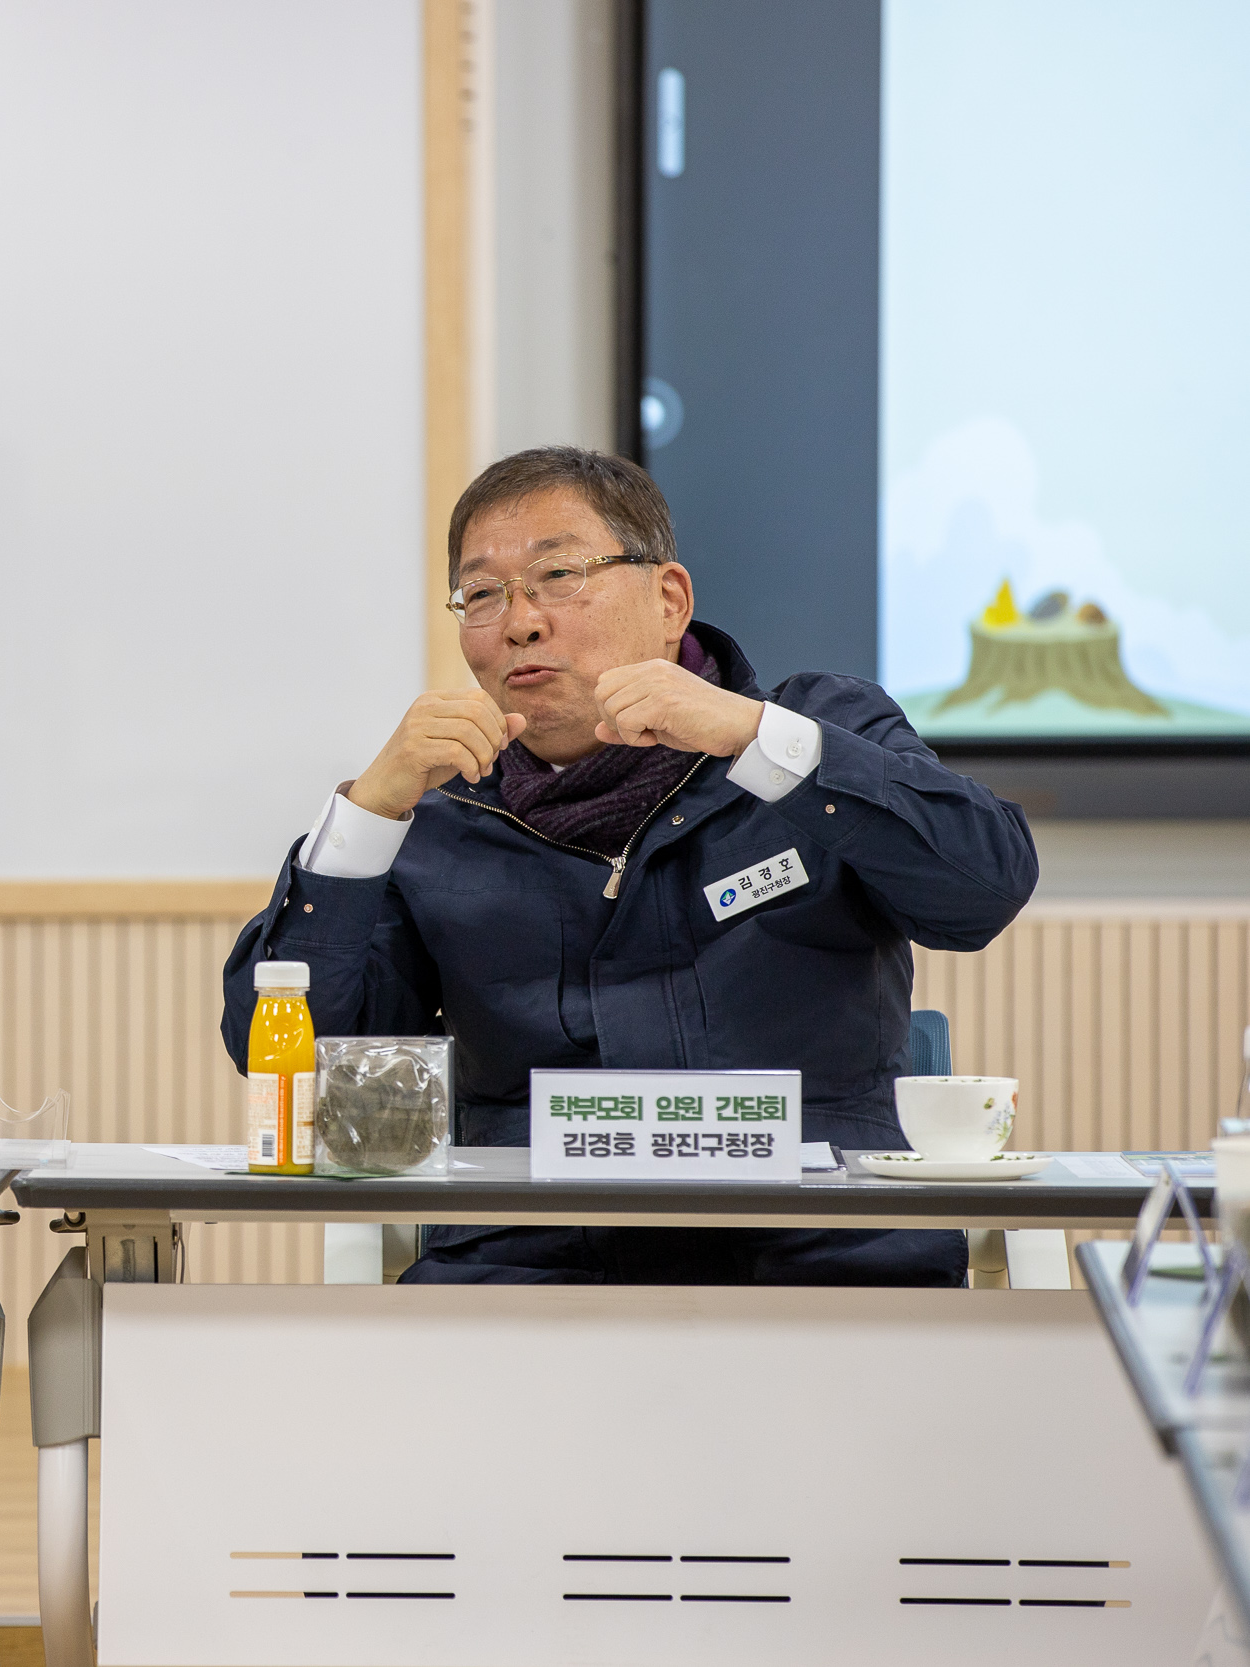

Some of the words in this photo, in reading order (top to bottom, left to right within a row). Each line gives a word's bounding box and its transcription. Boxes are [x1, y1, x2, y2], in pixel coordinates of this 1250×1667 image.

[751, 875, 791, 898] 광진구청장
[550, 1095, 644, 1121] 학부모회
[656, 1095, 704, 1121] 임원
[715, 1095, 787, 1122] 간담회
[563, 1132, 636, 1158] 김경호
[651, 1132, 775, 1159] 광진구청장
